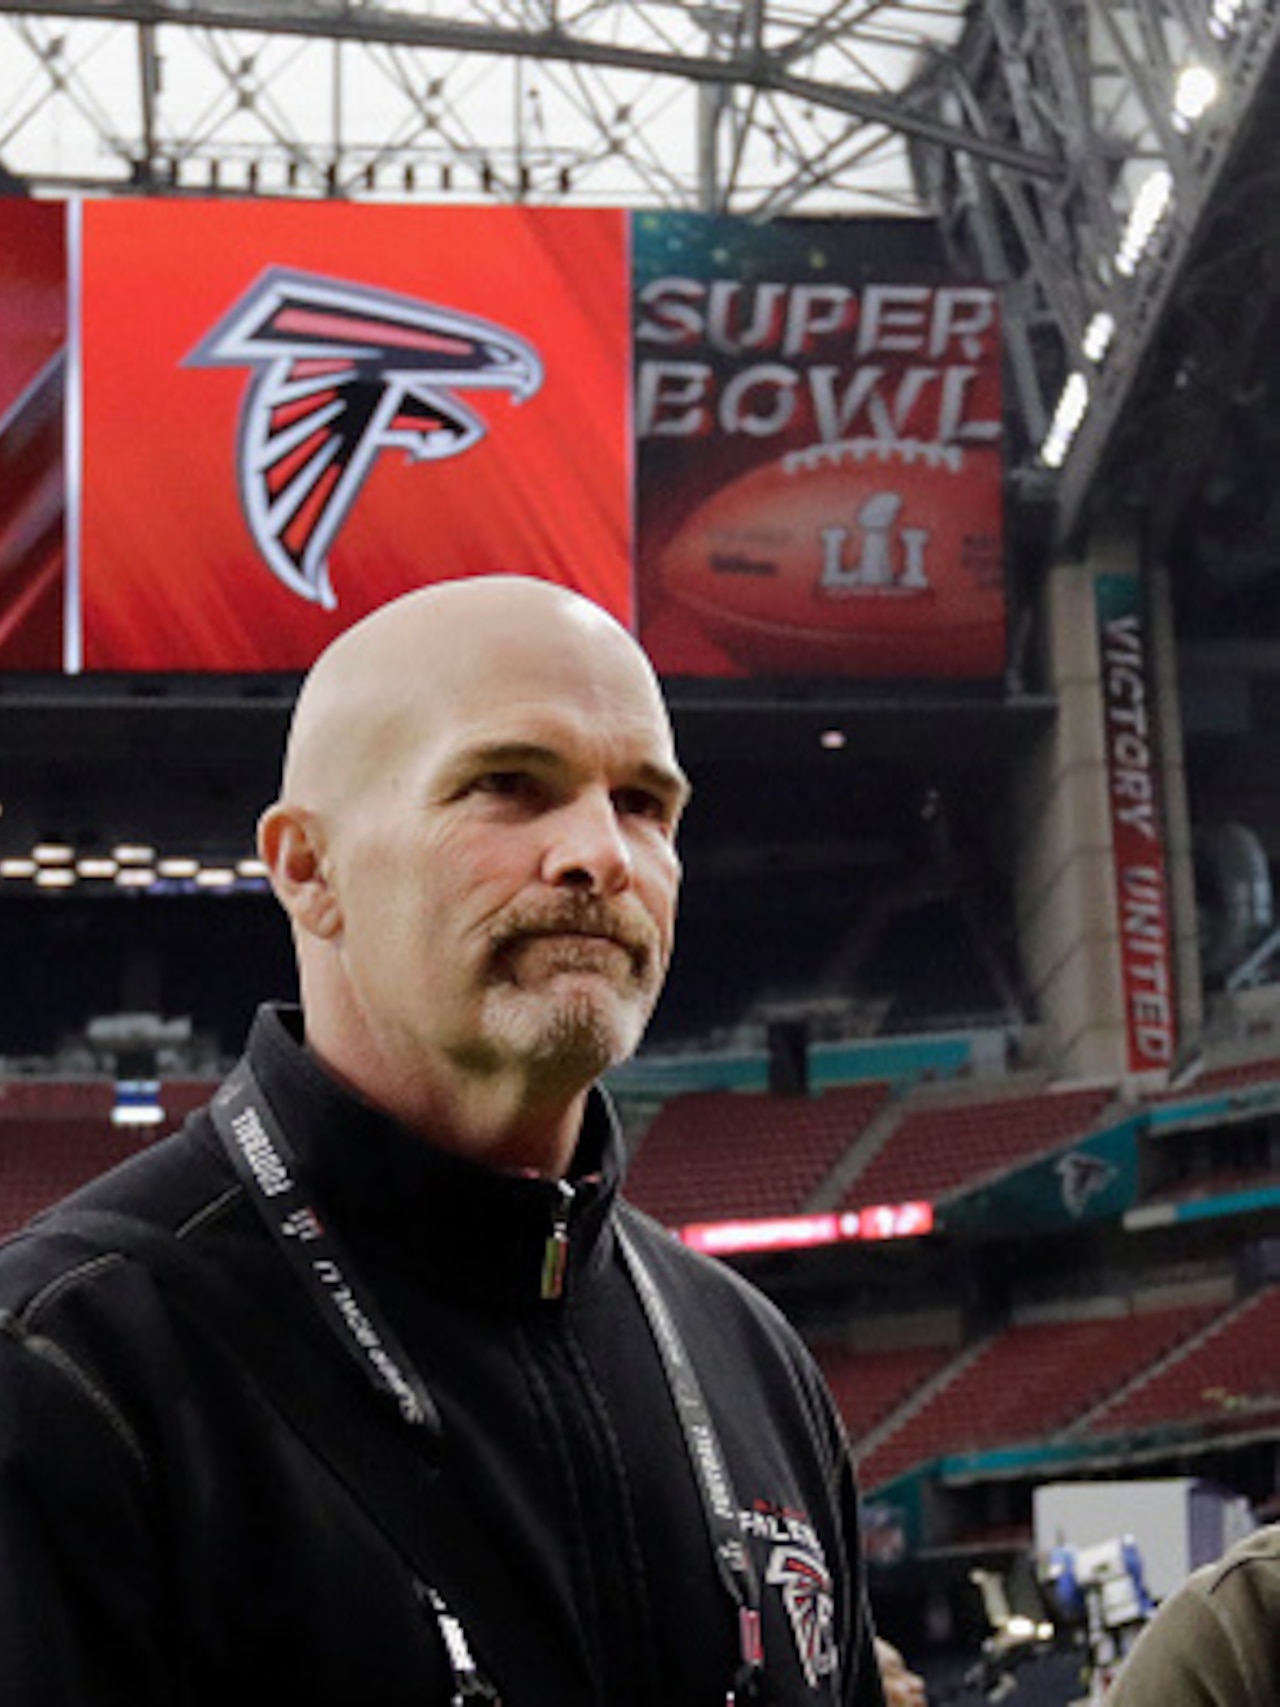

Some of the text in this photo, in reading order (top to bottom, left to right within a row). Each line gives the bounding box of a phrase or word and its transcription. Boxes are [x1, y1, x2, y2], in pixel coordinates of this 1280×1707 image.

[634, 276, 997, 360] SUPER
[634, 360, 1003, 442] BOWL
[1104, 613, 1174, 1062] VICTORY UNITED
